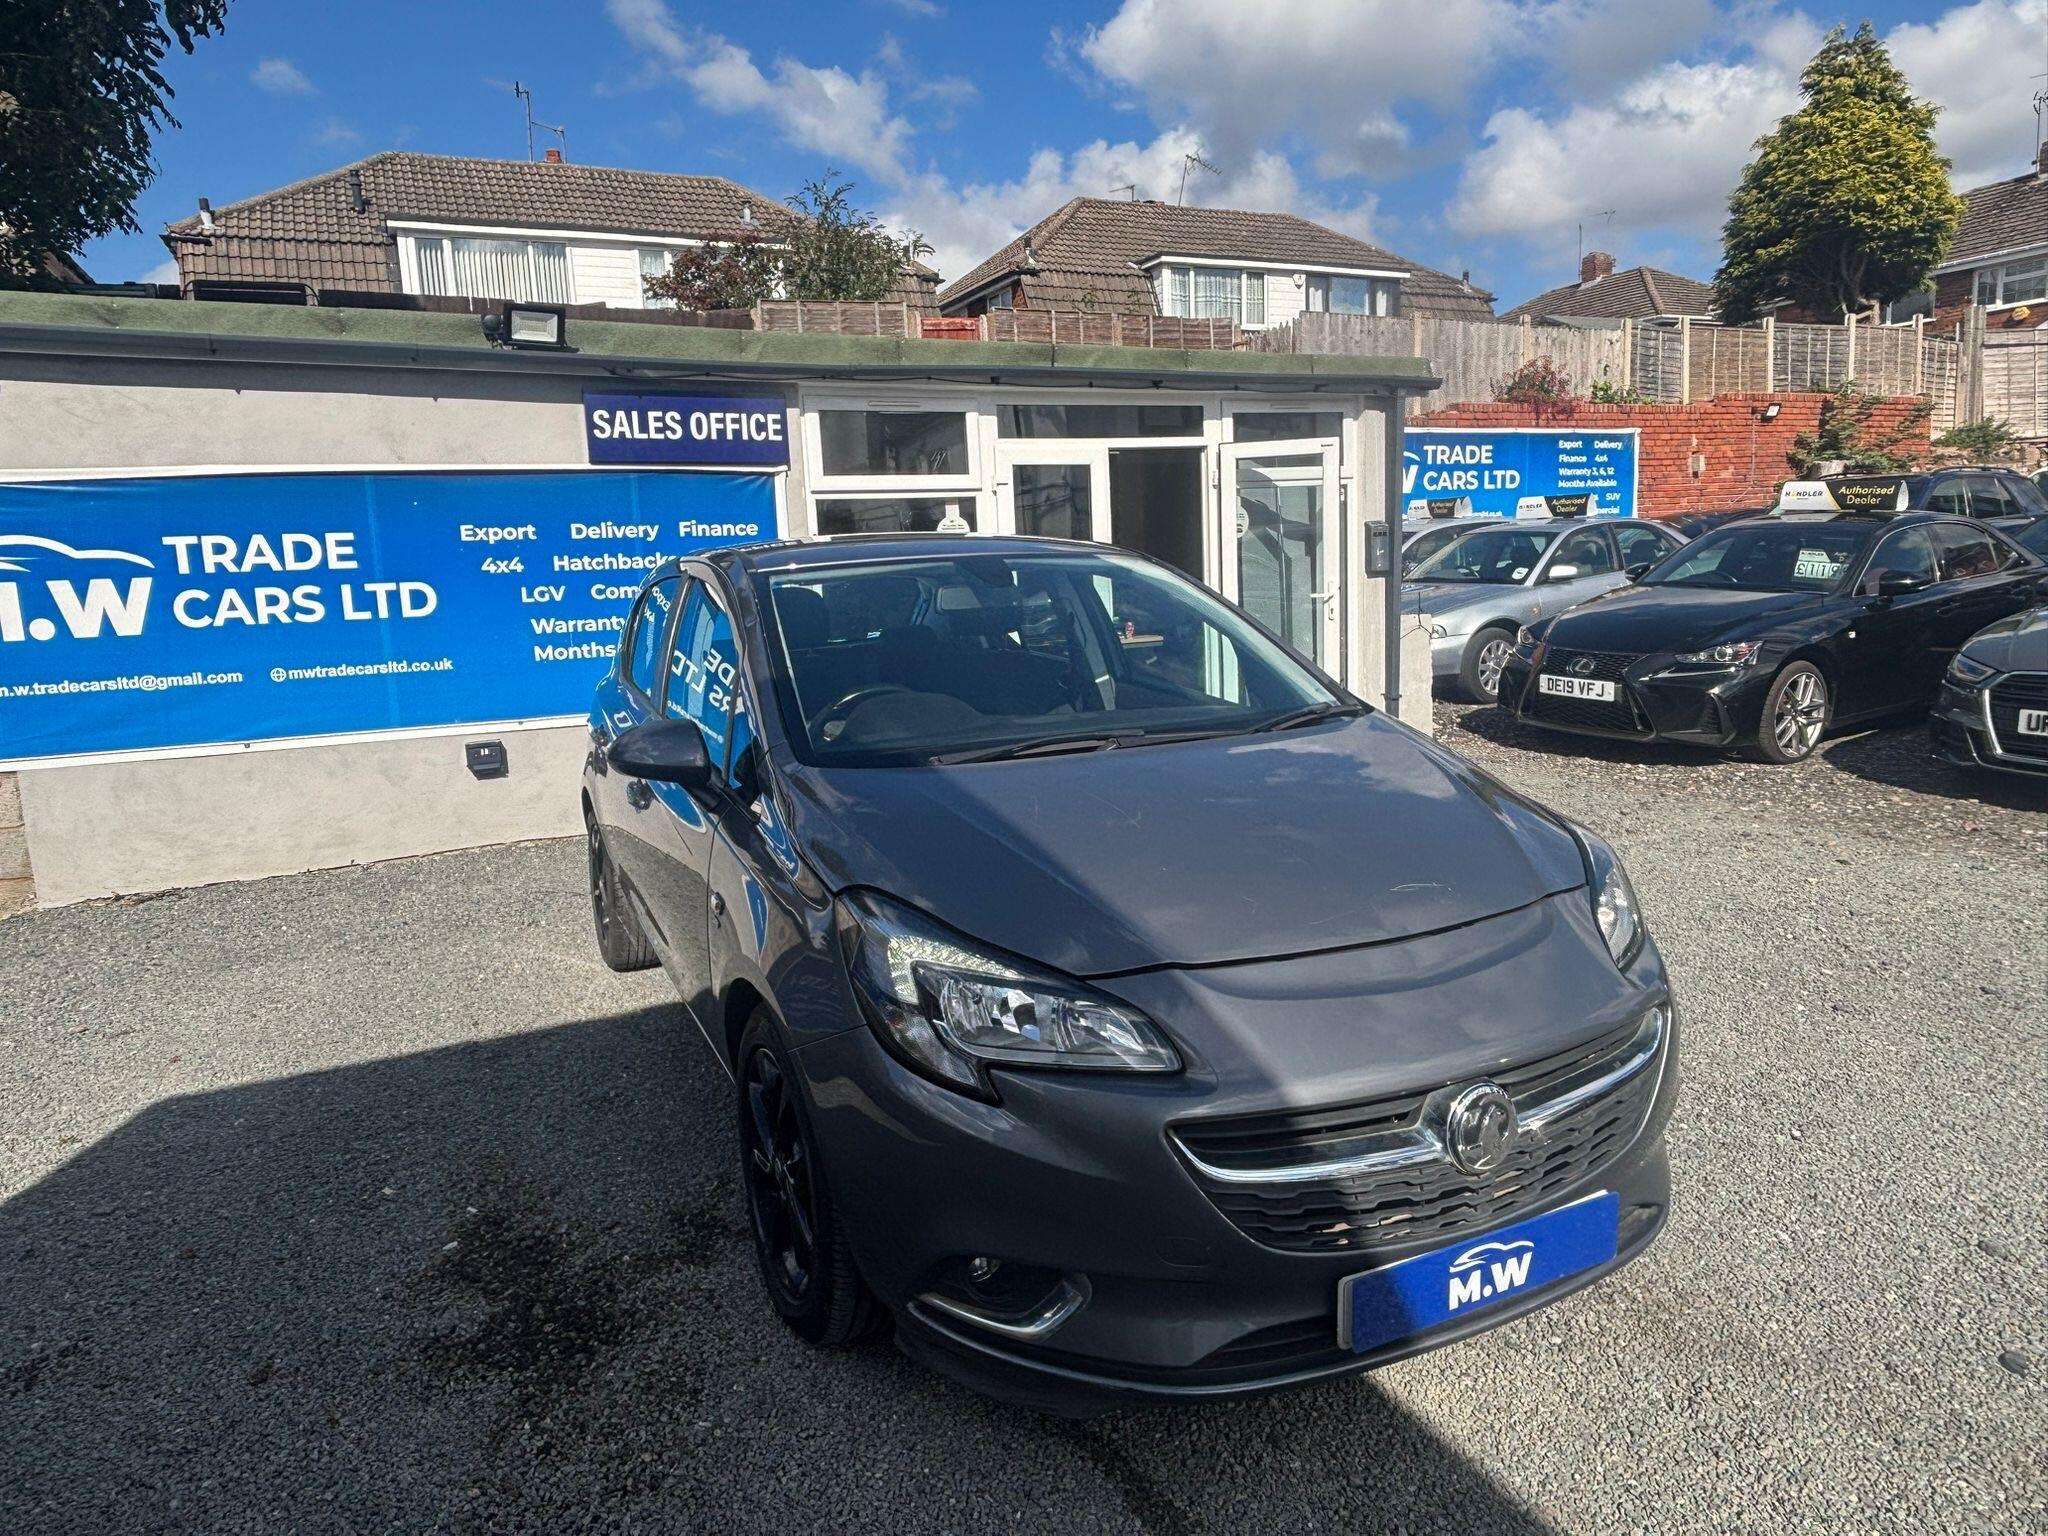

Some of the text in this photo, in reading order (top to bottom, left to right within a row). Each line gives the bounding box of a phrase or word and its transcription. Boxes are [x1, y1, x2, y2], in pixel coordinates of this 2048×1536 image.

[592, 409, 783, 441] SALES OFFICE
[1423, 445, 1493, 465] TRADE
[1559, 440, 1622, 450] Export Delivery
[1559, 454, 1587, 462] Finance
[1423, 470, 1479, 490] CARS
[1483, 470, 1520, 489] LTD
[1559, 468, 1591, 476] Warranty
[1839, 486, 1895, 495] Authorised
[1846, 494, 1881, 504] Dealer
[460, 520, 759, 544] Export Delivery Finance
[161, 532, 359, 575] TRADE
[481, 552, 676, 574] 4x4 Hatchback
[521, 584, 641, 603] LGV Com
[0, 577, 153, 641] .W
[173, 581, 438, 628] CARS LTD
[534, 641, 617, 661] Months
[288, 658, 453, 680] mwtradecarsltd.co.uk
[1547, 678, 1604, 698] DE19 VFJ
[1449, 1252, 1533, 1311] M.W
